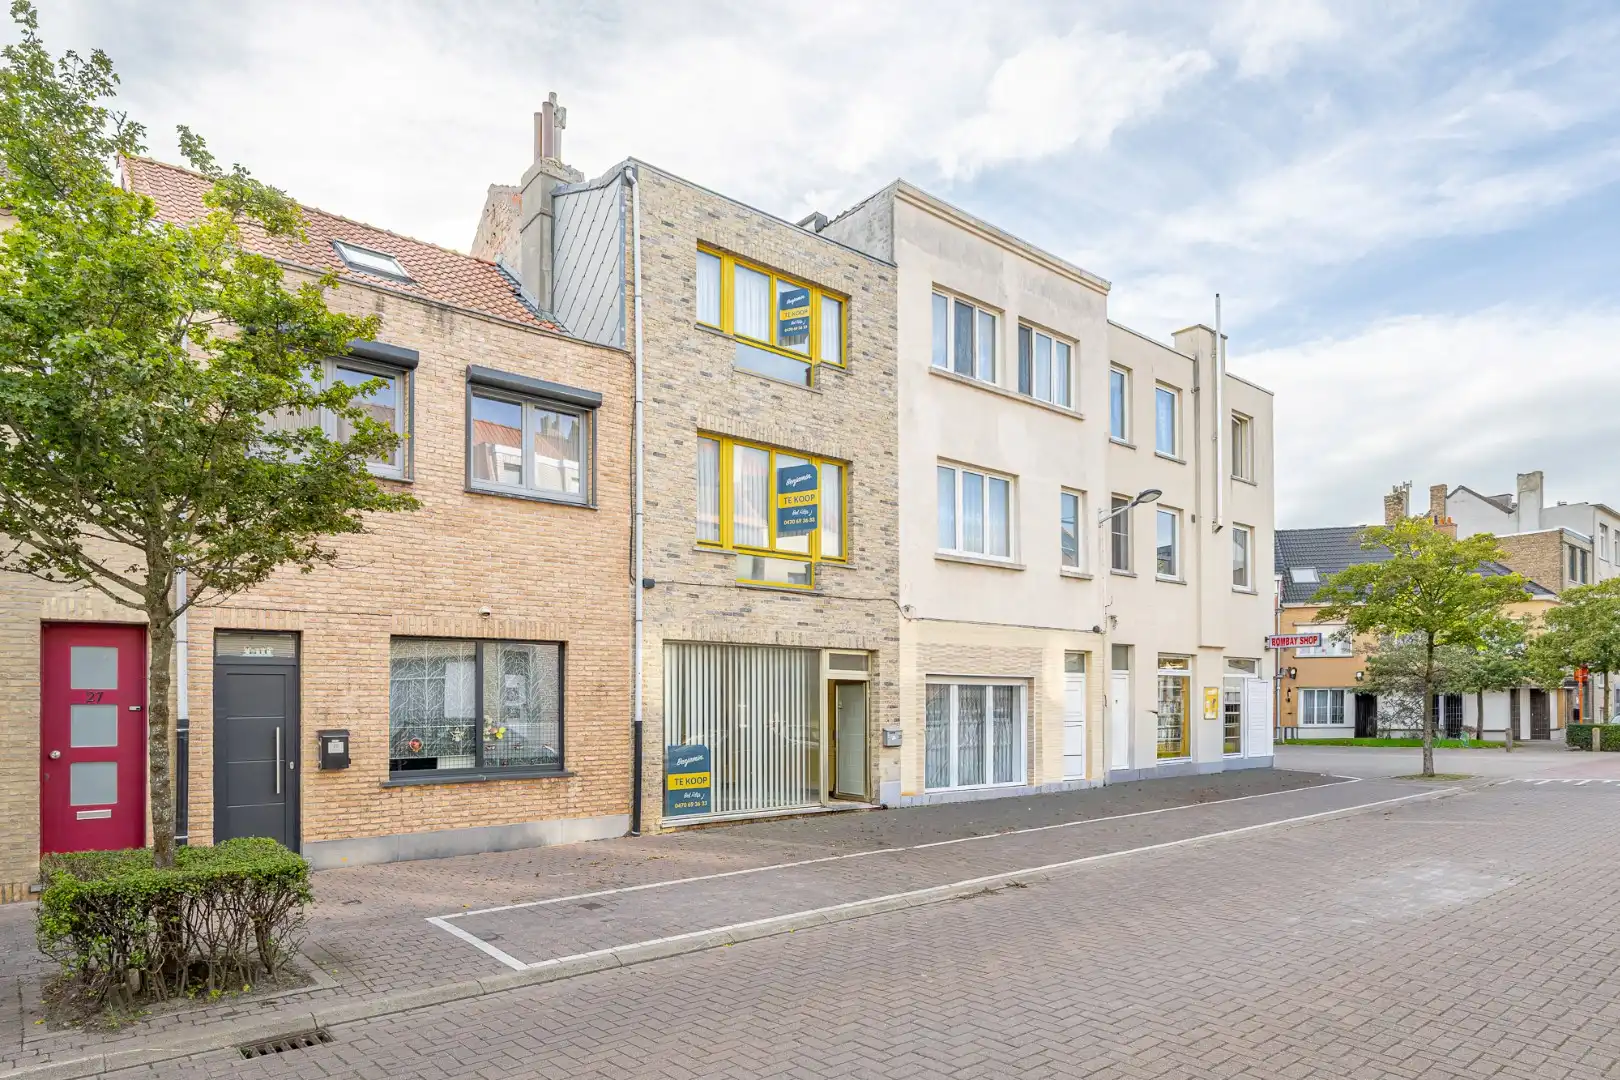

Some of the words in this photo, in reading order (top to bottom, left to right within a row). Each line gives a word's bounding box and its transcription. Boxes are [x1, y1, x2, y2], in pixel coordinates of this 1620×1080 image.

[791, 308, 808, 317] KOOP
[784, 496, 792, 504] TE
[793, 493, 815, 503] KOOP
[1271, 637, 1298, 647] BOMBAY
[1299, 635, 1318, 645] SHOP
[86, 691, 103, 703] 27
[674, 777, 684, 786] TE
[685, 776, 708, 785] KOOP
